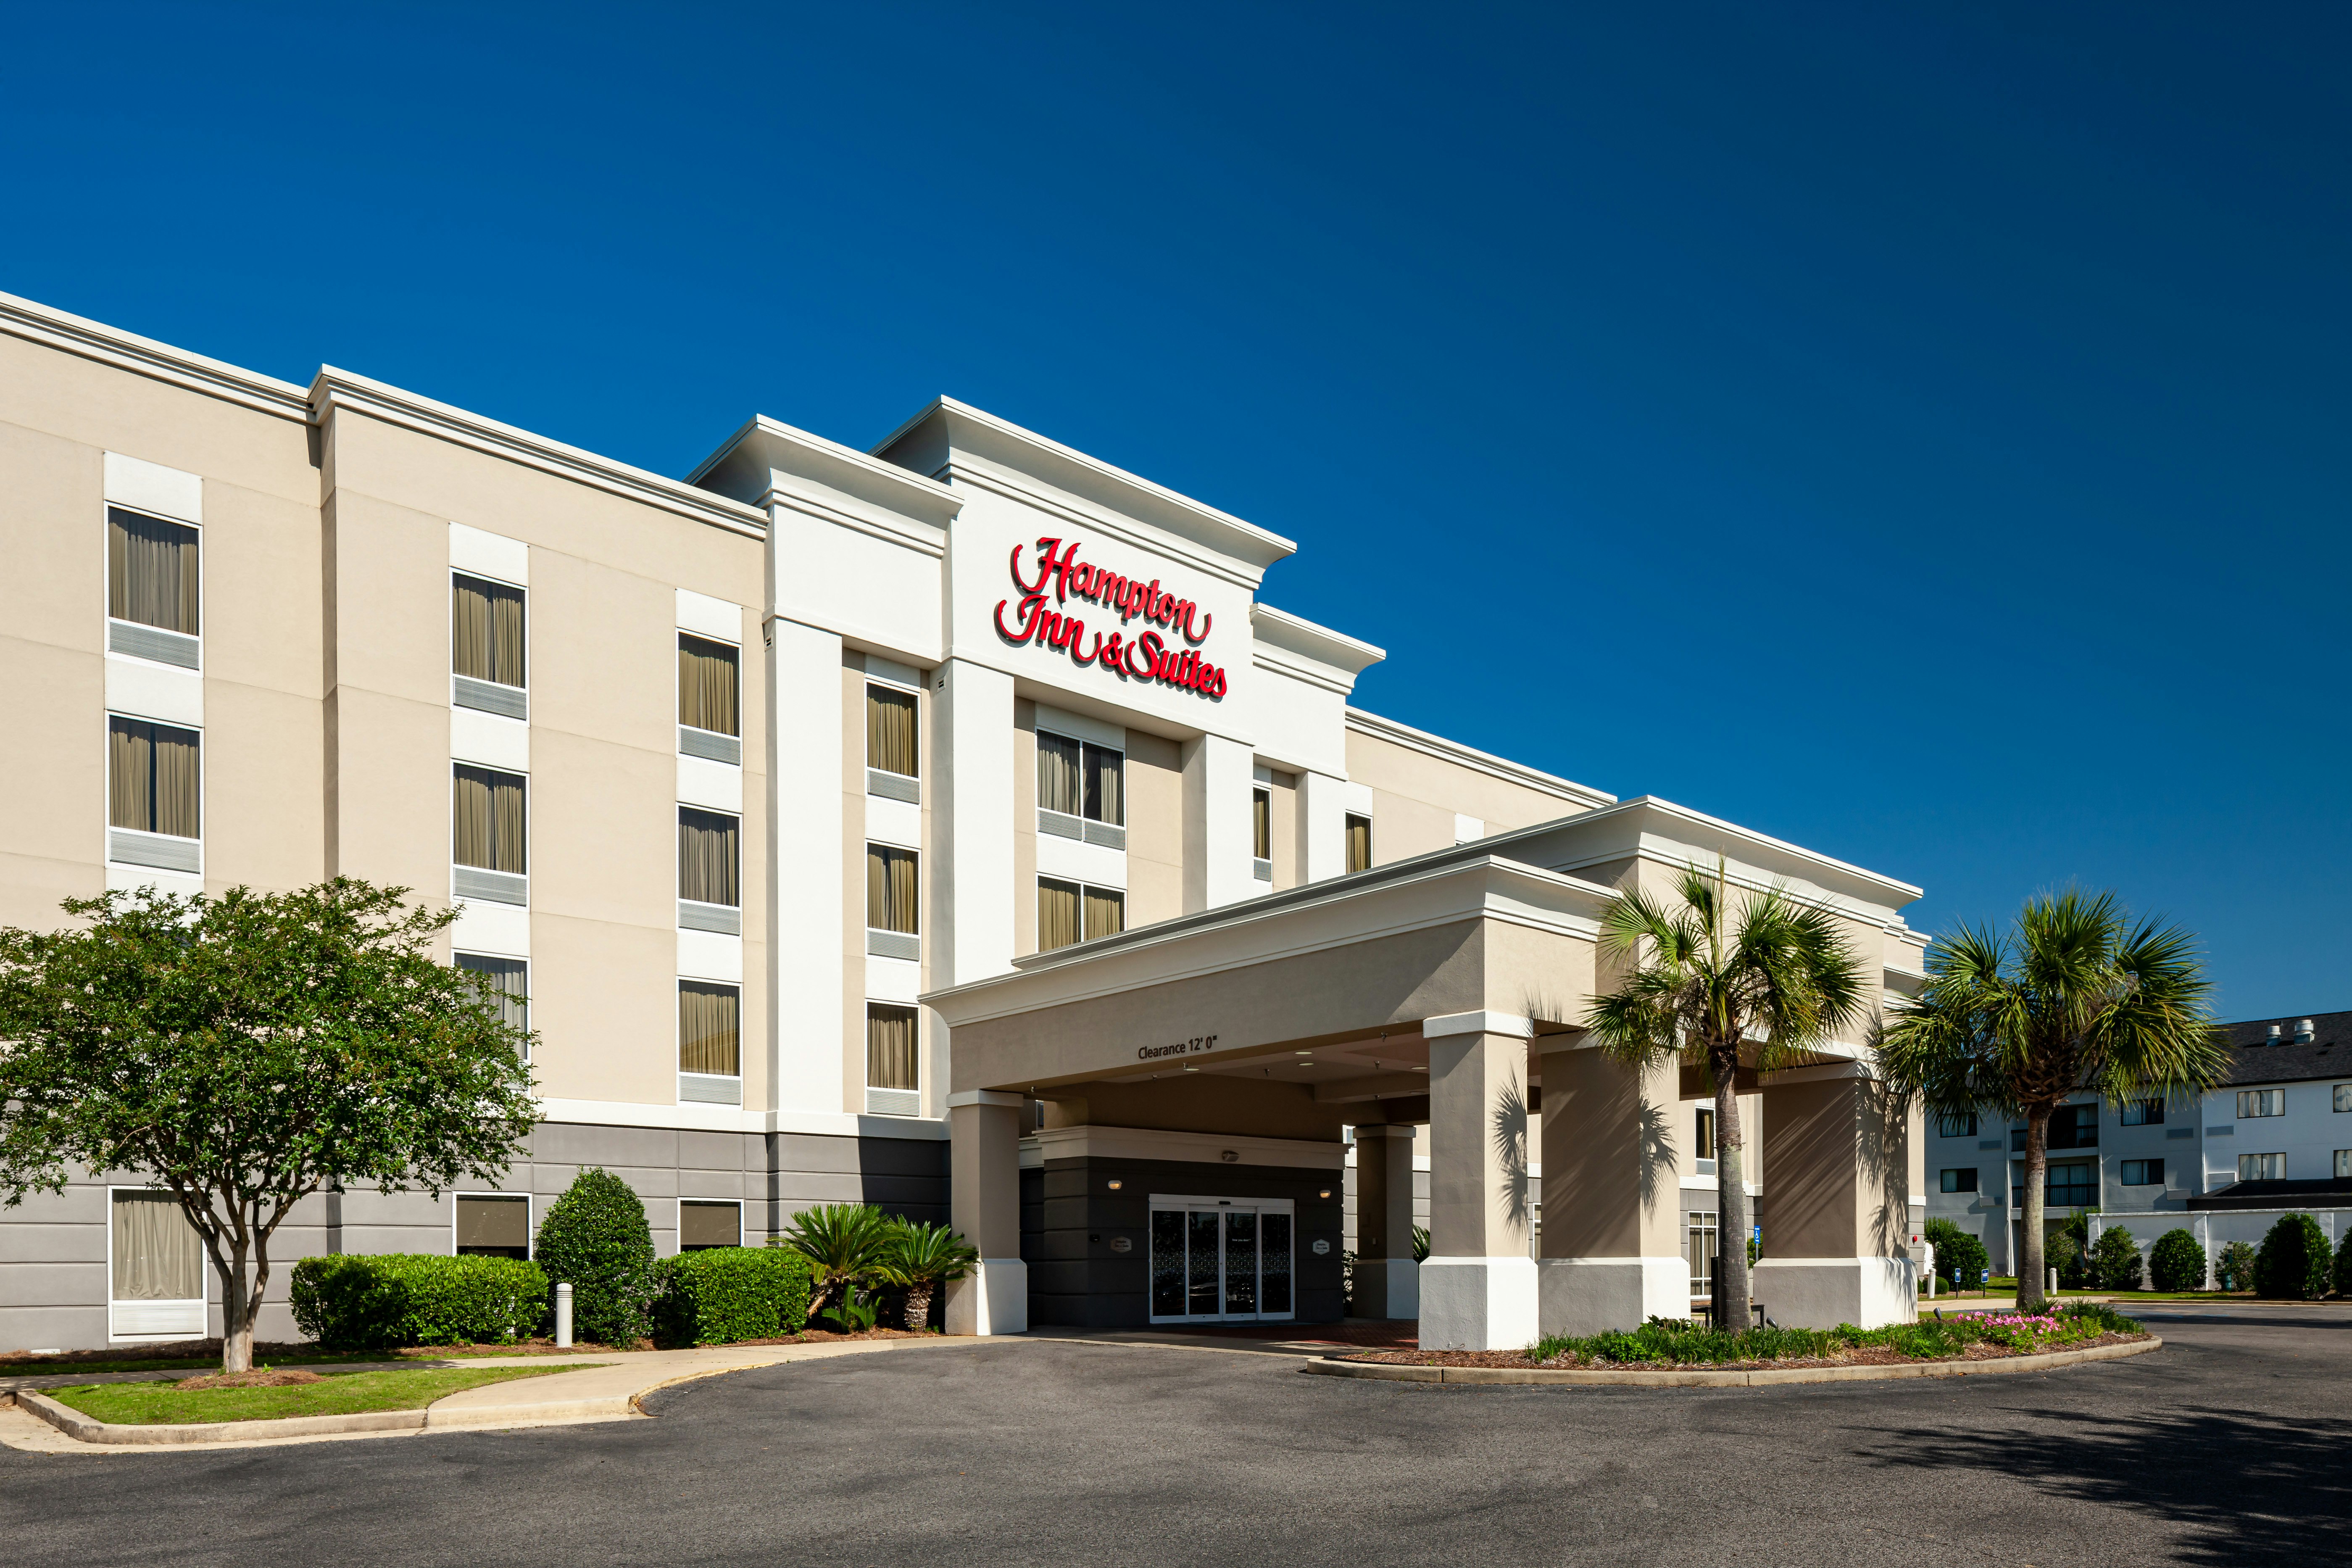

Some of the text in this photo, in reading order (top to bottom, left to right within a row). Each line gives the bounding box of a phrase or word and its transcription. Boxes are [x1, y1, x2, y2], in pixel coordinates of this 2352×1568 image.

[1012, 537, 1212, 641] Hampton
[996, 594, 1227, 697] Inn & Suites
[1138, 1044, 1186, 1059] Clearance
[1188, 1037, 1203, 1051] 12'
